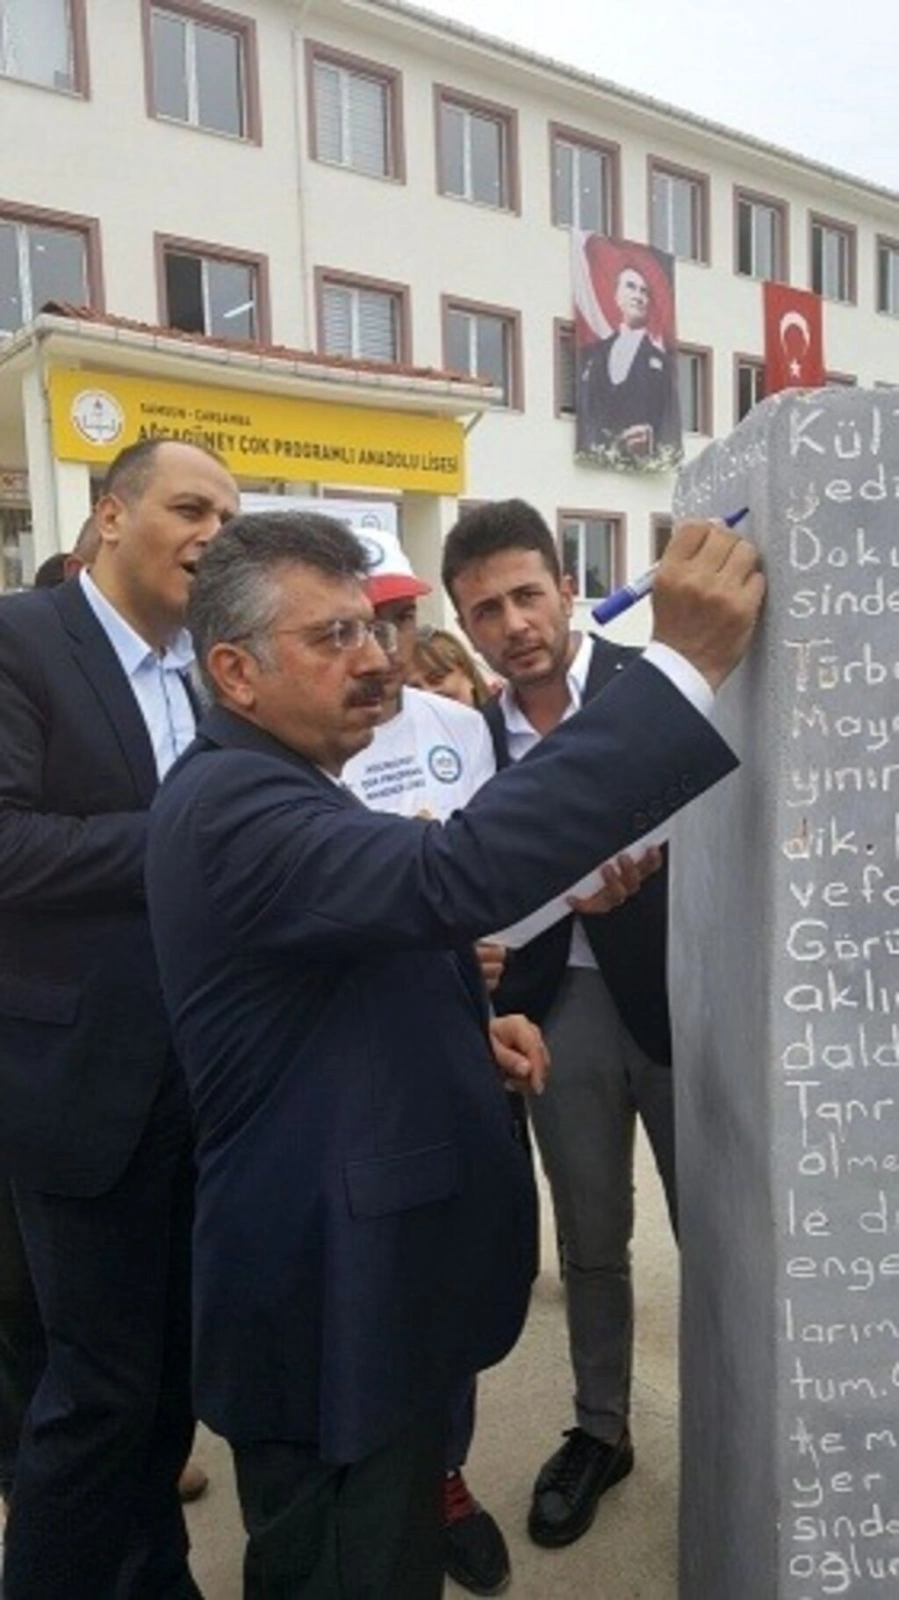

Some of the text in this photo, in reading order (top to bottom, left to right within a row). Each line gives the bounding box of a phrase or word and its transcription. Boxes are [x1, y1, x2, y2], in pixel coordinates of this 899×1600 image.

[240, 434, 270, 455] ÇOK
[274, 438, 355, 465] PROGRAMLI
[358, 448, 420, 471] ANADOLU
[421, 452, 459, 474] LİSESİ
[789, 407, 881, 458] Kül
[784, 641, 899, 692] Türb
[790, 703, 899, 752] May
[783, 968, 899, 1014] aklı
[858, 1188, 899, 1236] d
[791, 1470, 882, 1509] yer
